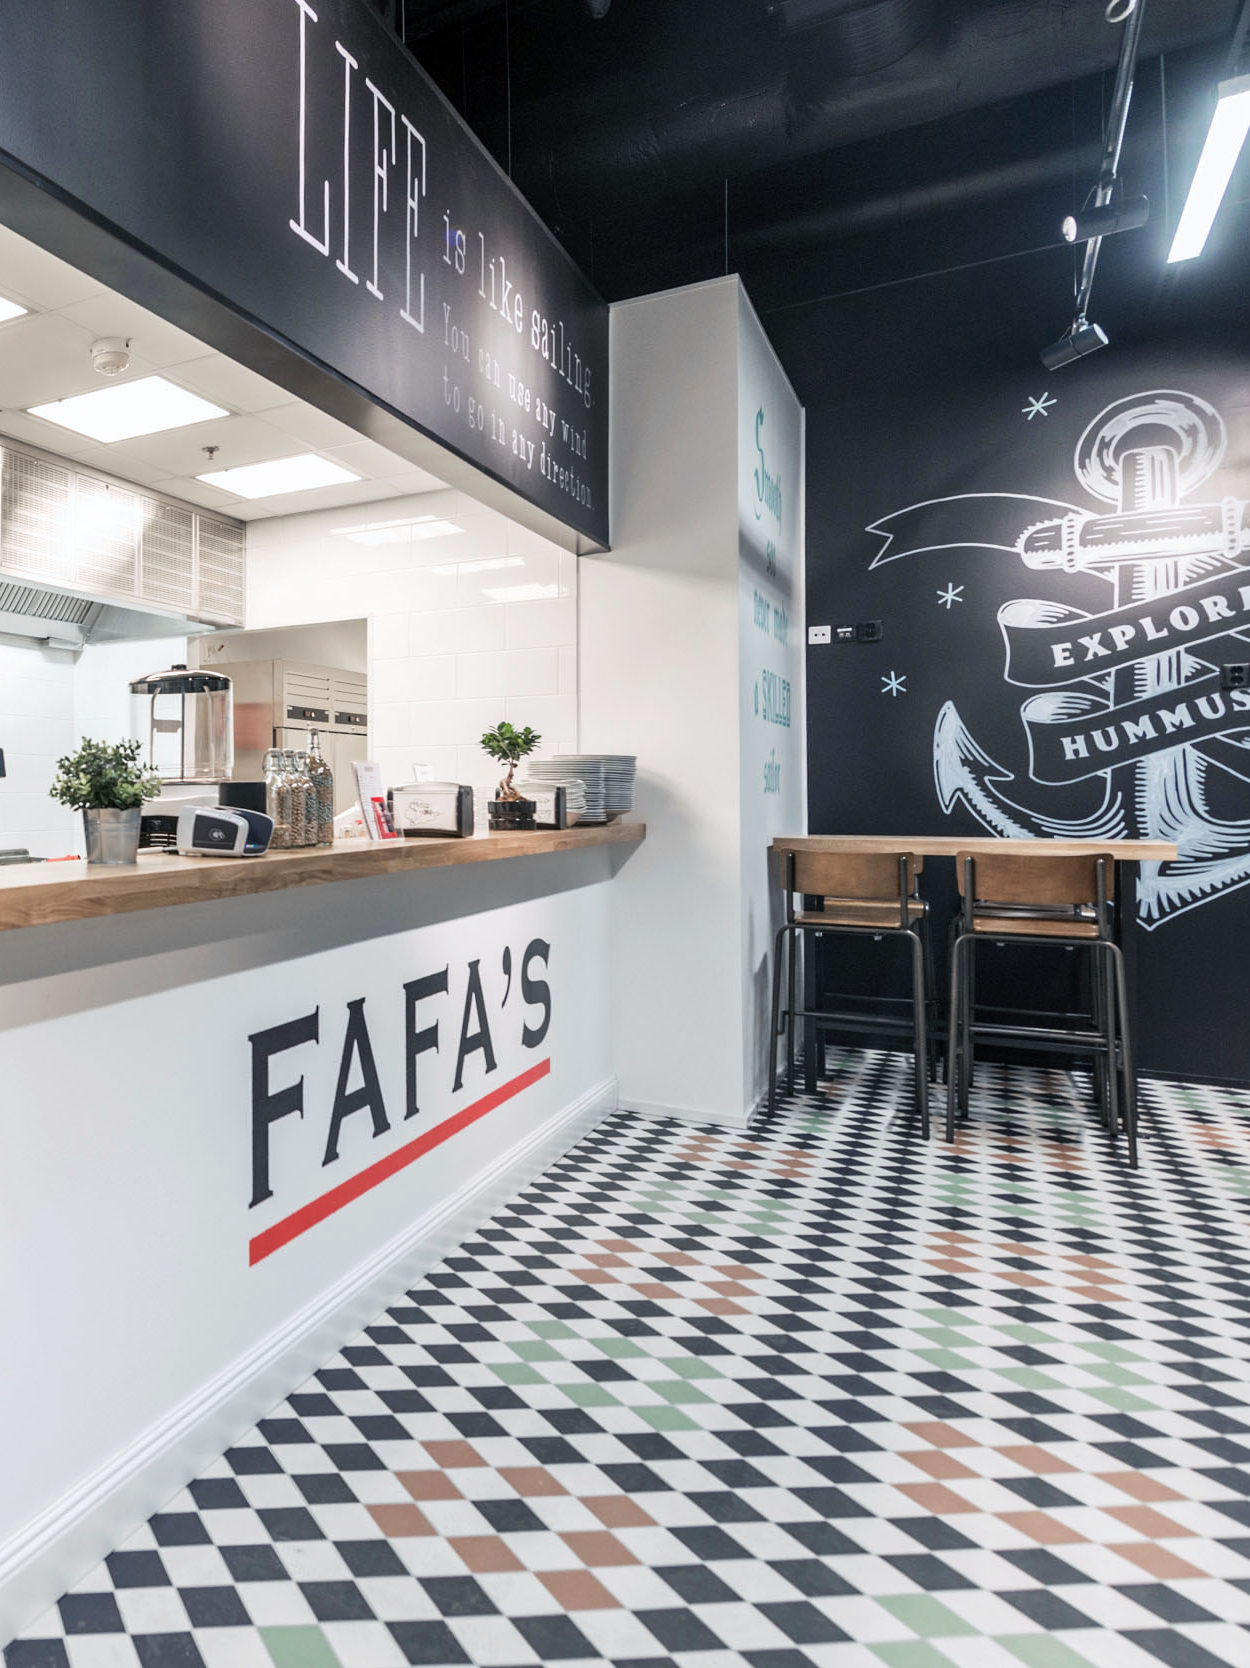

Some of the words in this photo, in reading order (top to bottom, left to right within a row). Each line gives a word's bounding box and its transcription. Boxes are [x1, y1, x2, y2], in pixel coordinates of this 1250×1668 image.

[289, 0, 426, 334] LIFE
[442, 209, 466, 275] is
[478, 231, 523, 333] like
[442, 302, 470, 363] You
[478, 349, 500, 388] can
[507, 373, 530, 412] use
[535, 397, 556, 437] any
[561, 419, 587, 461] wind
[442, 364, 460, 414] to
[468, 396, 484, 431] go
[491, 409, 505, 445] in
[511, 429, 534, 469] any
[762, 668, 791, 728] SKILLED
[1060, 687, 1250, 760] HUMMUS
